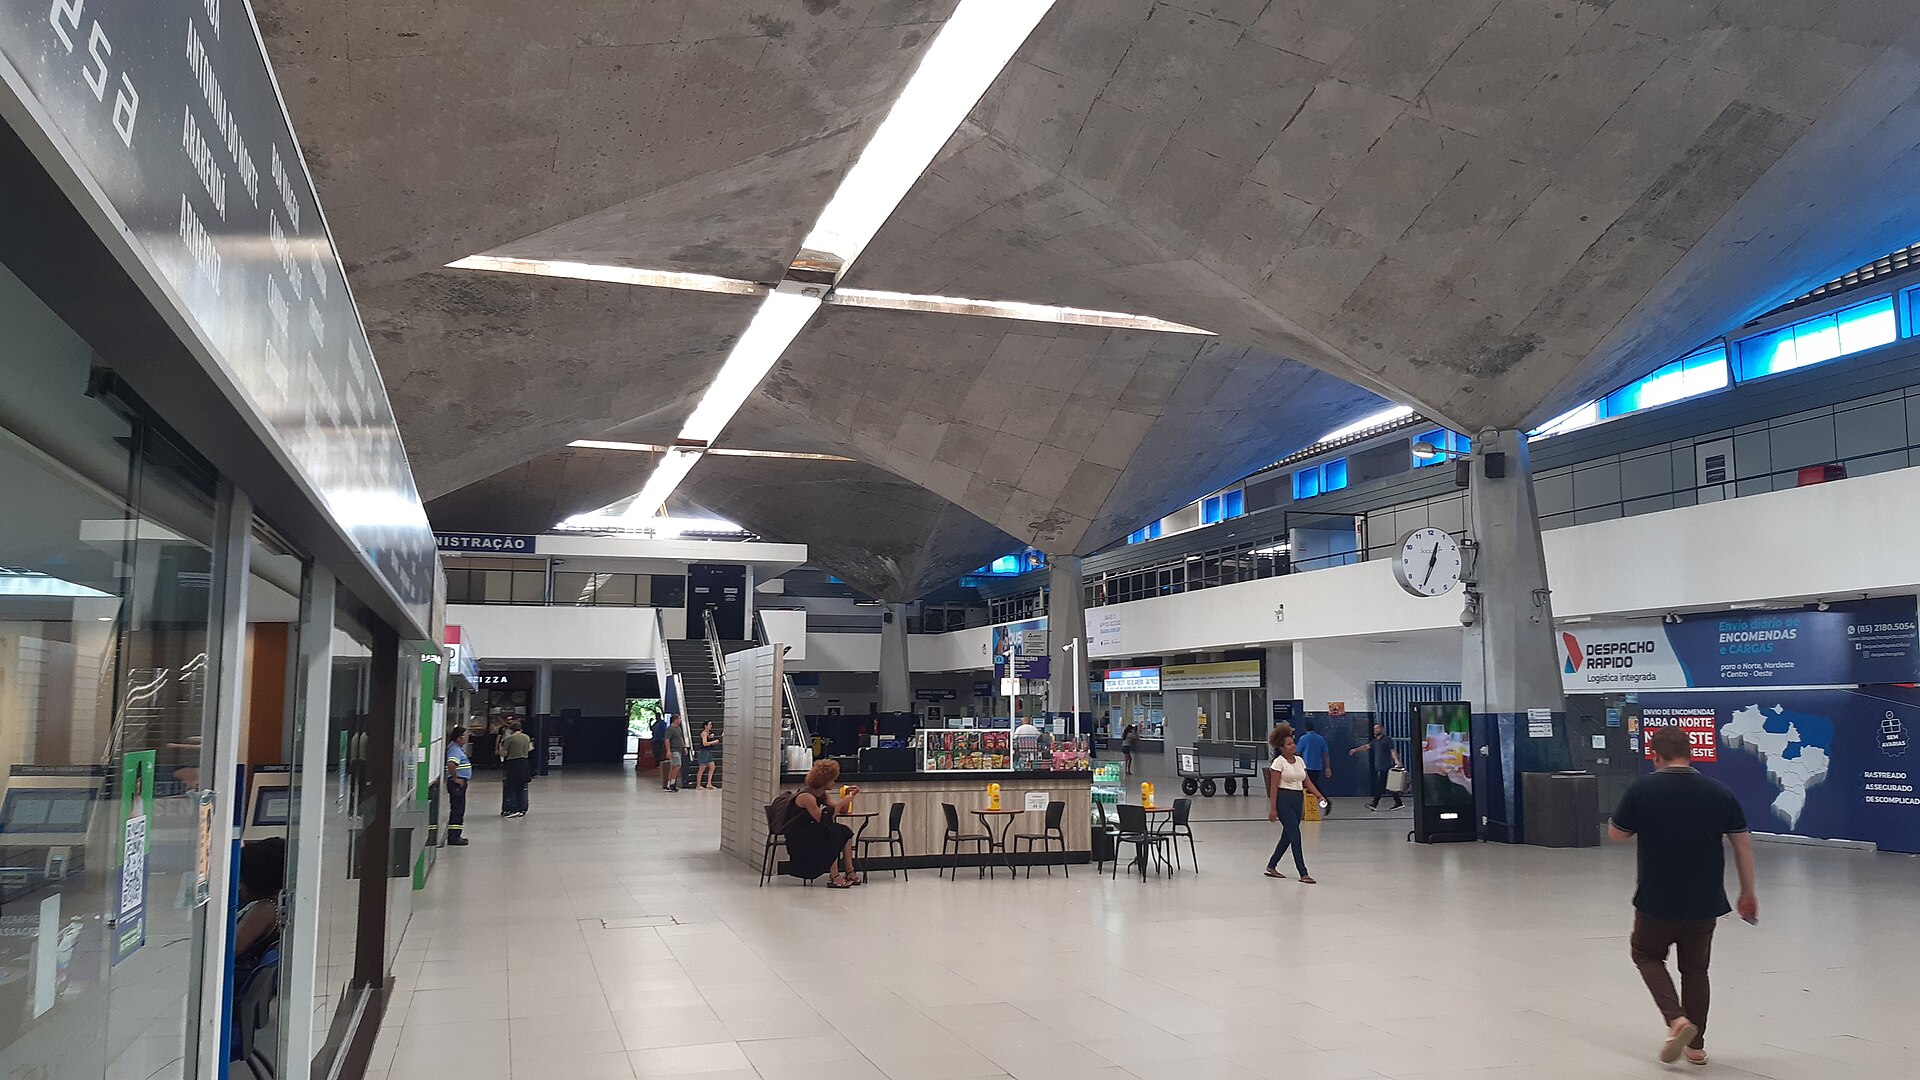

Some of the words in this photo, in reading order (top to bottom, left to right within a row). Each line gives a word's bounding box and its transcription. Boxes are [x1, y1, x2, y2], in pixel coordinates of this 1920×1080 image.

[186, 17, 227, 142] ANTONINA
[228, 111, 238, 163] DO
[238, 135, 258, 209] NORTE
[183, 104, 226, 222] ARARENDÁ
[1719, 620, 1747, 631] Envio
[1786, 617, 1800, 627] de
[1857, 625, 1873, 634] (85)
[1874, 622, 1915, 632] 2180.5054
[1719, 629, 1797, 643] ENCOMENDAS
[1586, 640, 1655, 656] DESPACHO
[1720, 646, 1726, 654] e
[1729, 643, 1774, 654] CARGAS
[1586, 656, 1633, 669] RAPIDO
[1743, 662, 1763, 670] Norte,
[1764, 661, 1795, 669] Nordeste
[1620, 671, 1657, 683] integrada
[1726, 670, 1749, 678] Centro
[1671, 708, 1715, 716] ENCOMENDAS
[1643, 717, 1669, 727] PARA
[1669, 717, 1678, 727] O
[1679, 717, 1715, 728] NORTE,
[1644, 747, 1651, 755] E
[1864, 771, 1907, 779] RASTREADO
[1865, 784, 1913, 792] ASSEGURADO
